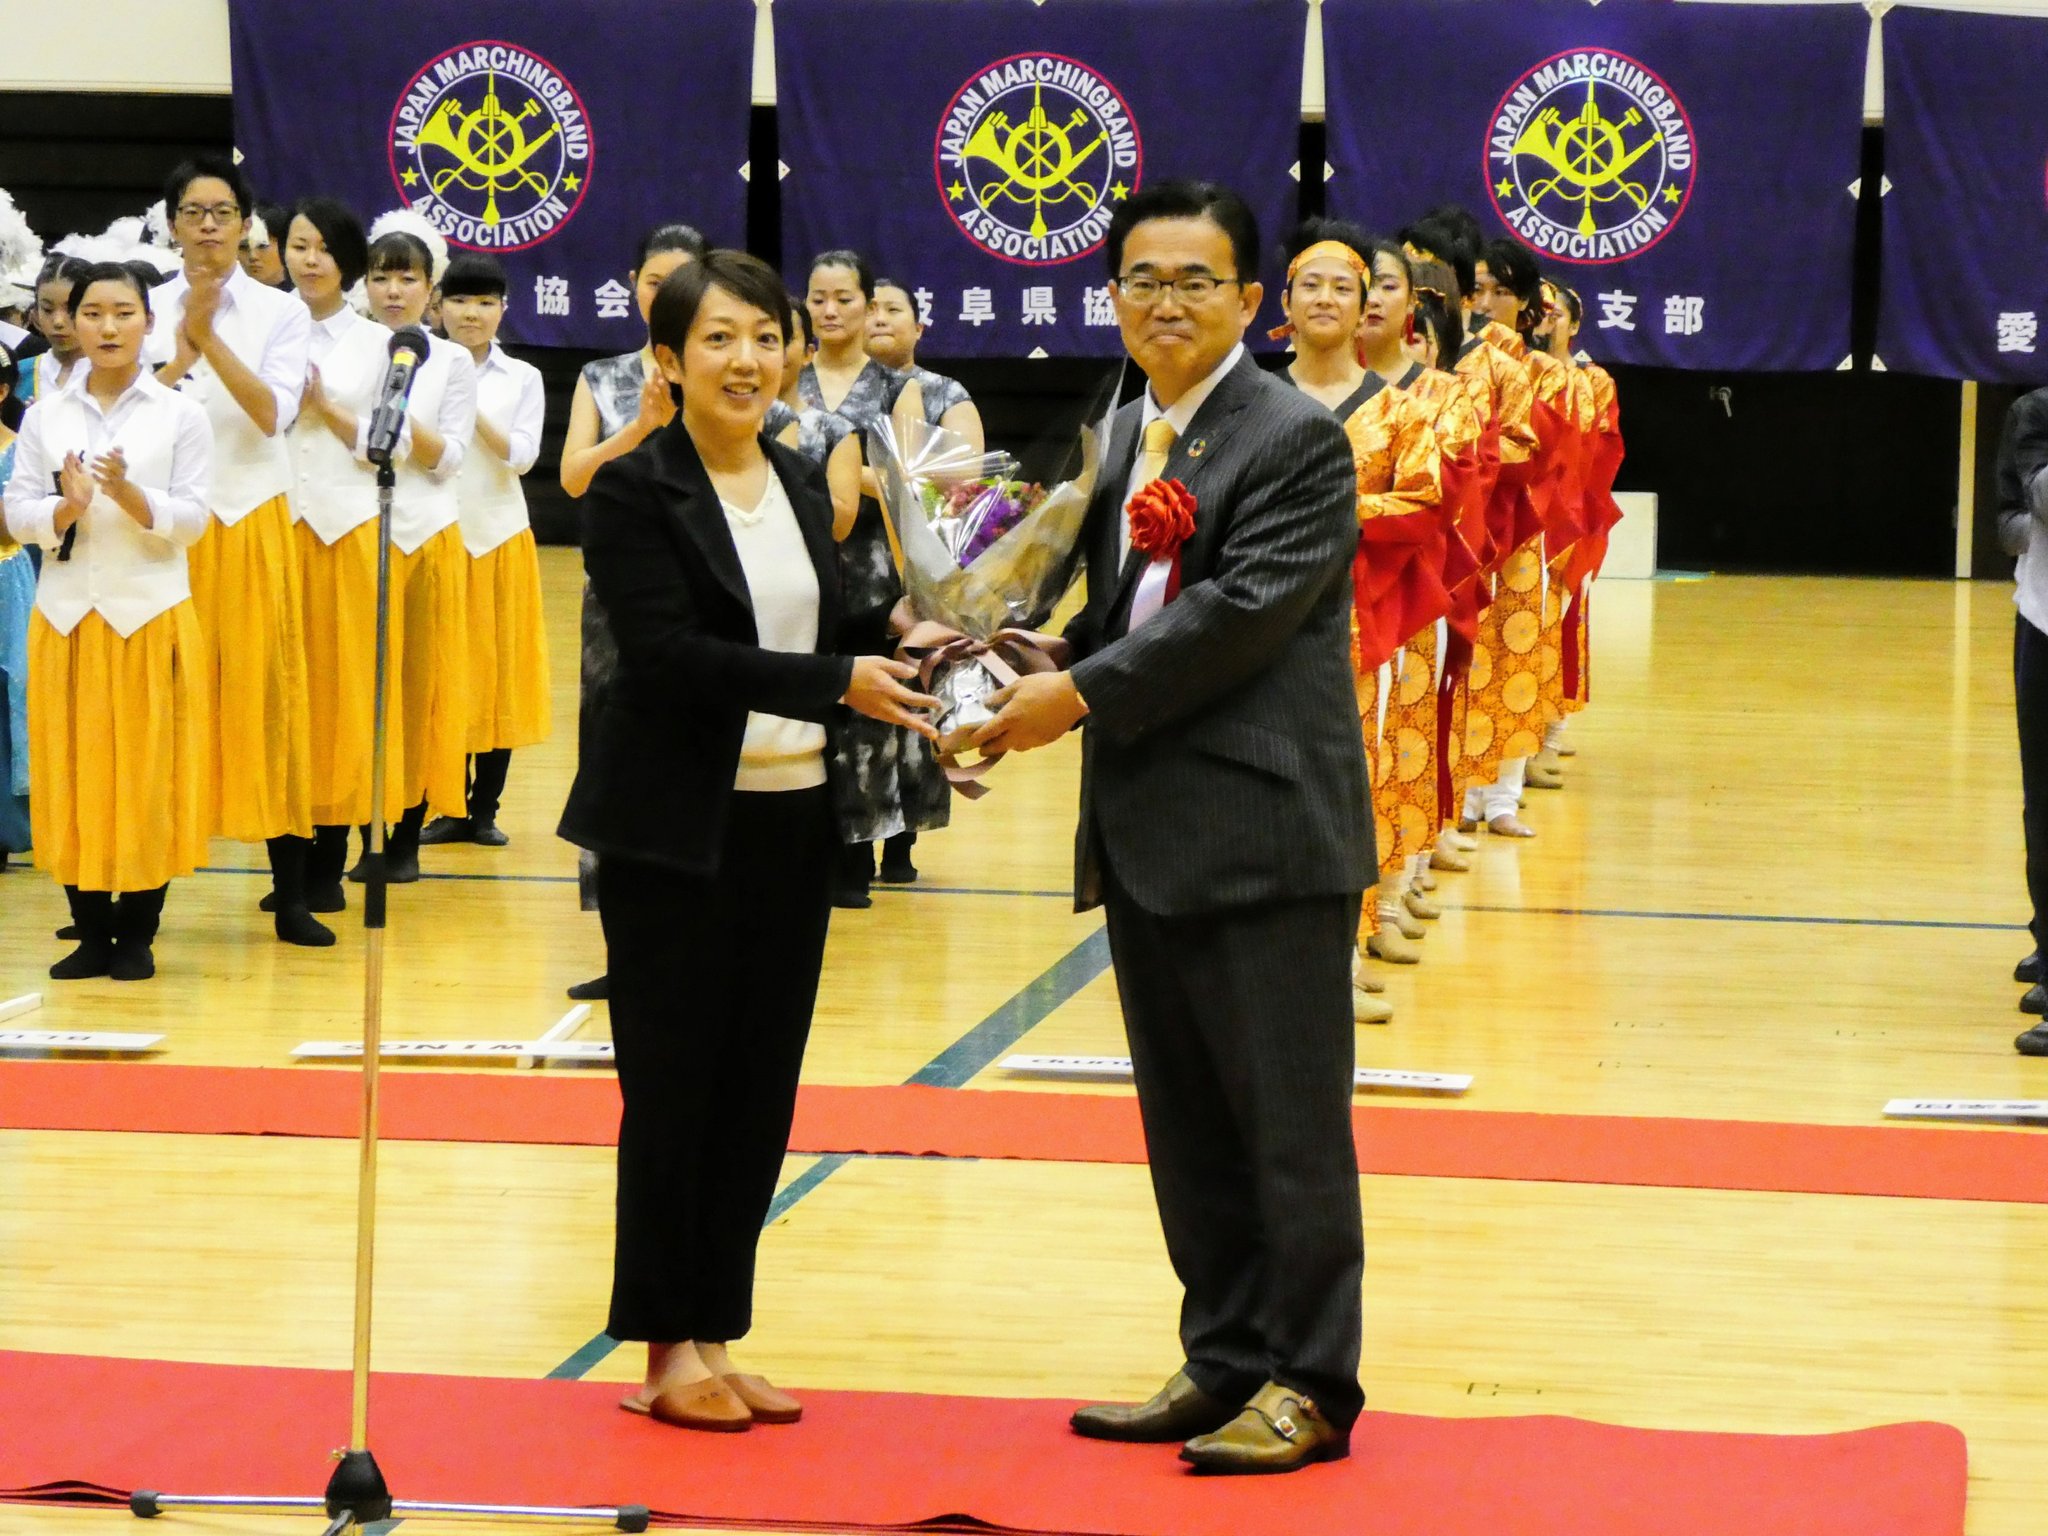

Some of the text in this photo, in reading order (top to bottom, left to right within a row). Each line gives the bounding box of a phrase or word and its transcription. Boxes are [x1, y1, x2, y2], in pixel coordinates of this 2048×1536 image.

[395, 46, 588, 160] JAPAN MARCHINGBAND
[940, 58, 1137, 168] JAPAN MARCHINGBAND
[1490, 53, 1691, 170] JAPAN MARCHINGBAND
[411, 194, 569, 246] ASSOCIATION
[958, 205, 1114, 260] ASSOCIATION
[1505, 205, 1669, 259] ASSOCIATION
[1597, 289, 1705, 335] 支部
[1997, 311, 2038, 353] 愛
